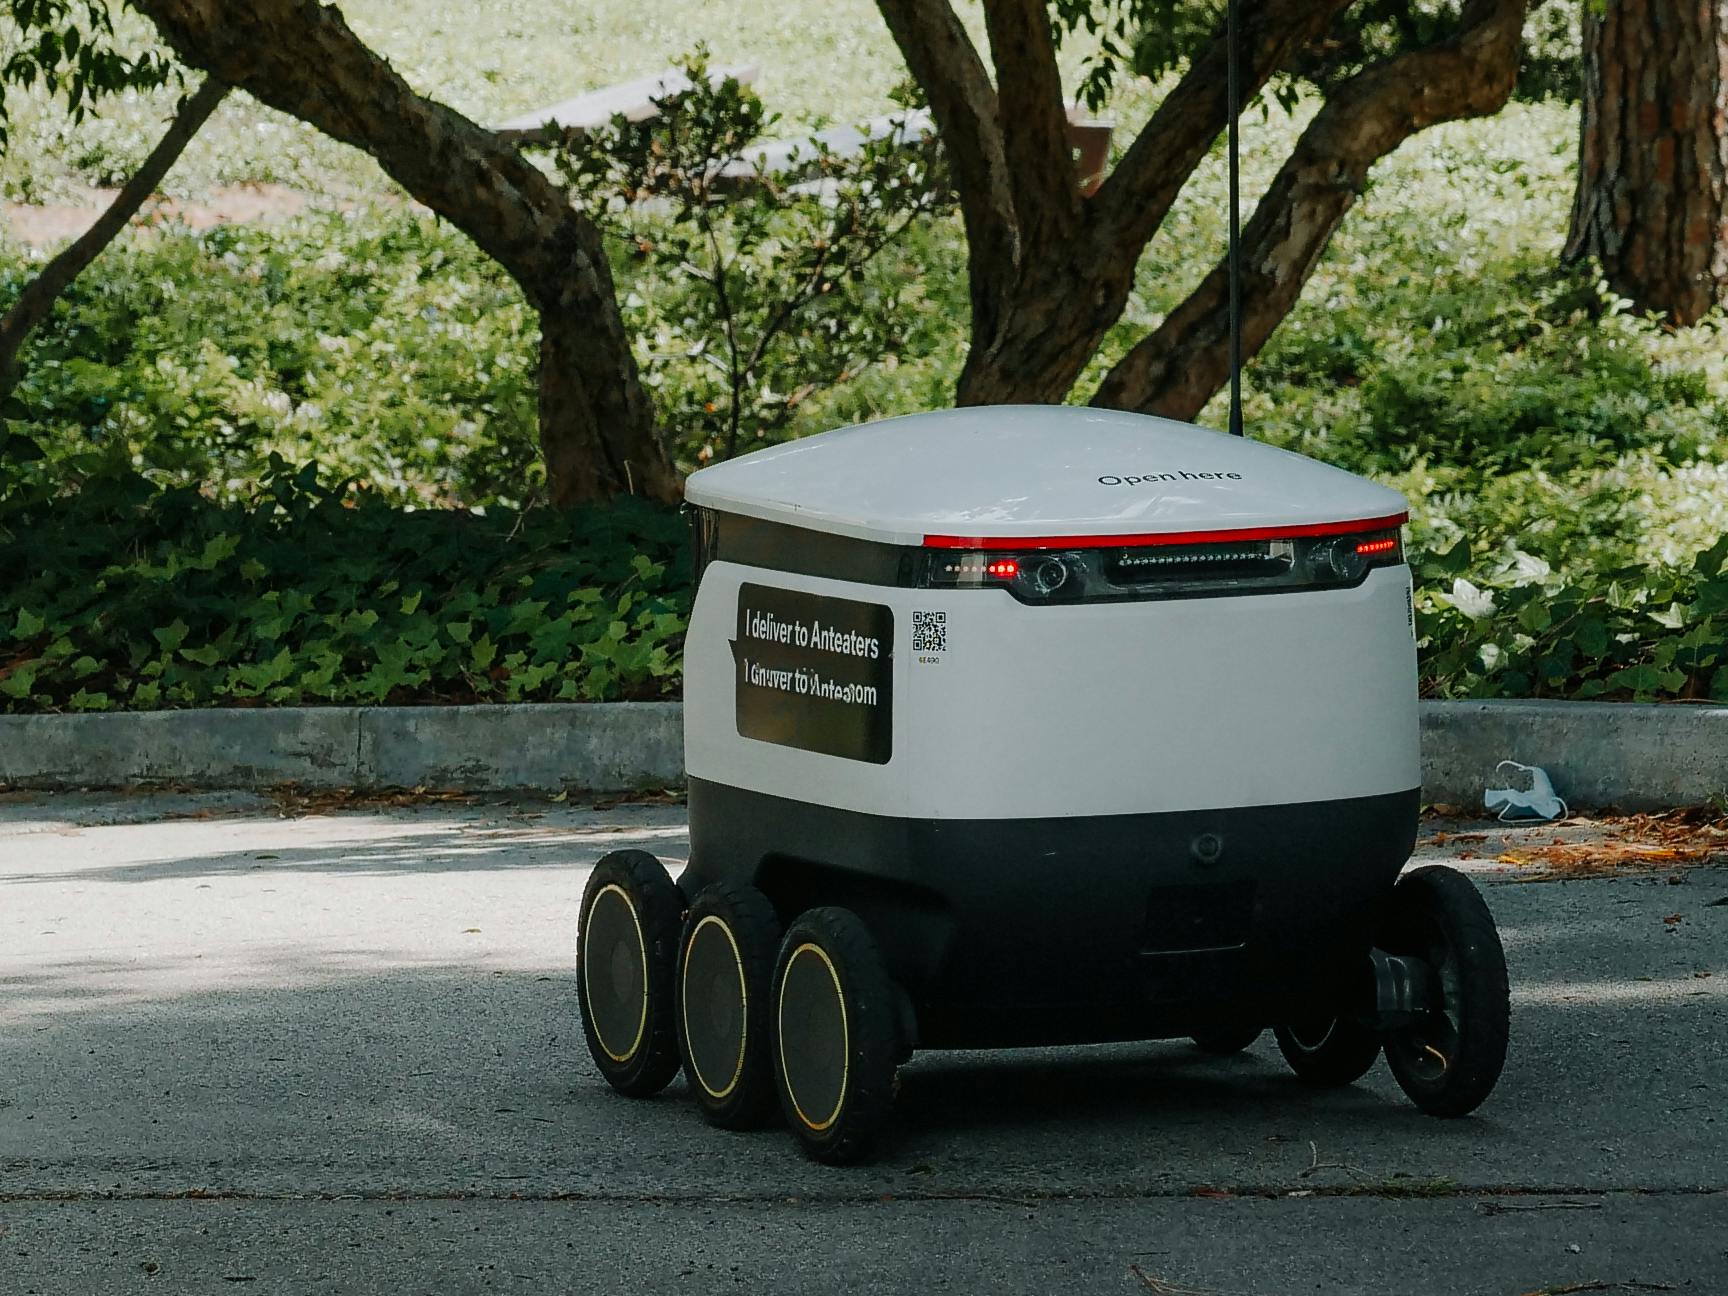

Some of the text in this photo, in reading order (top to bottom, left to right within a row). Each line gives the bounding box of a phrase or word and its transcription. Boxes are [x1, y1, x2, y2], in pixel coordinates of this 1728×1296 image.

[1098, 470, 1242, 486] Open here
[752, 610, 793, 644] deliver
[795, 620, 808, 647] to
[810, 620, 879, 659] Anteaters
